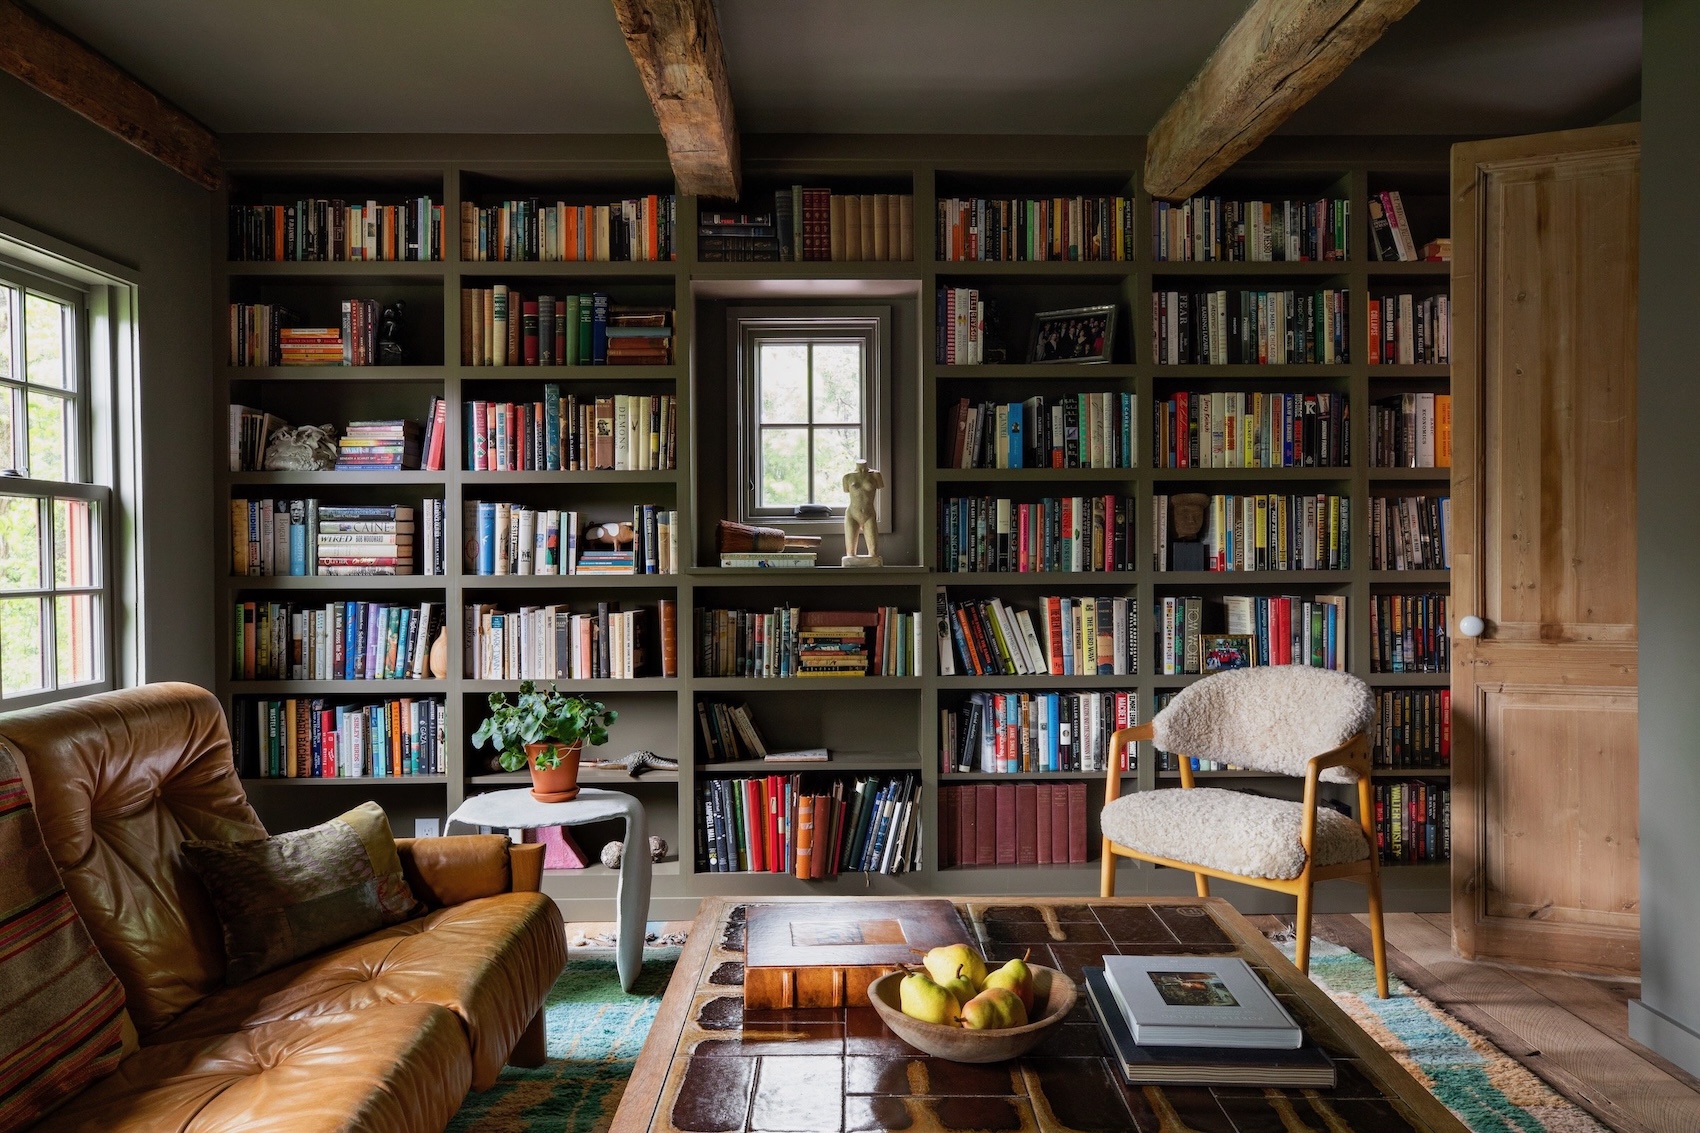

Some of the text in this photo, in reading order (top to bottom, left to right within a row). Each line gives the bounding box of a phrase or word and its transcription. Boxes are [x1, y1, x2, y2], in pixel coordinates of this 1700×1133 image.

[354, 523, 390, 532] CAINE
[1186, 607, 1198, 632] TOM
[1118, 697, 1126, 724] MACBETH
[1392, 787, 1401, 854] WALTER MOSLEY
